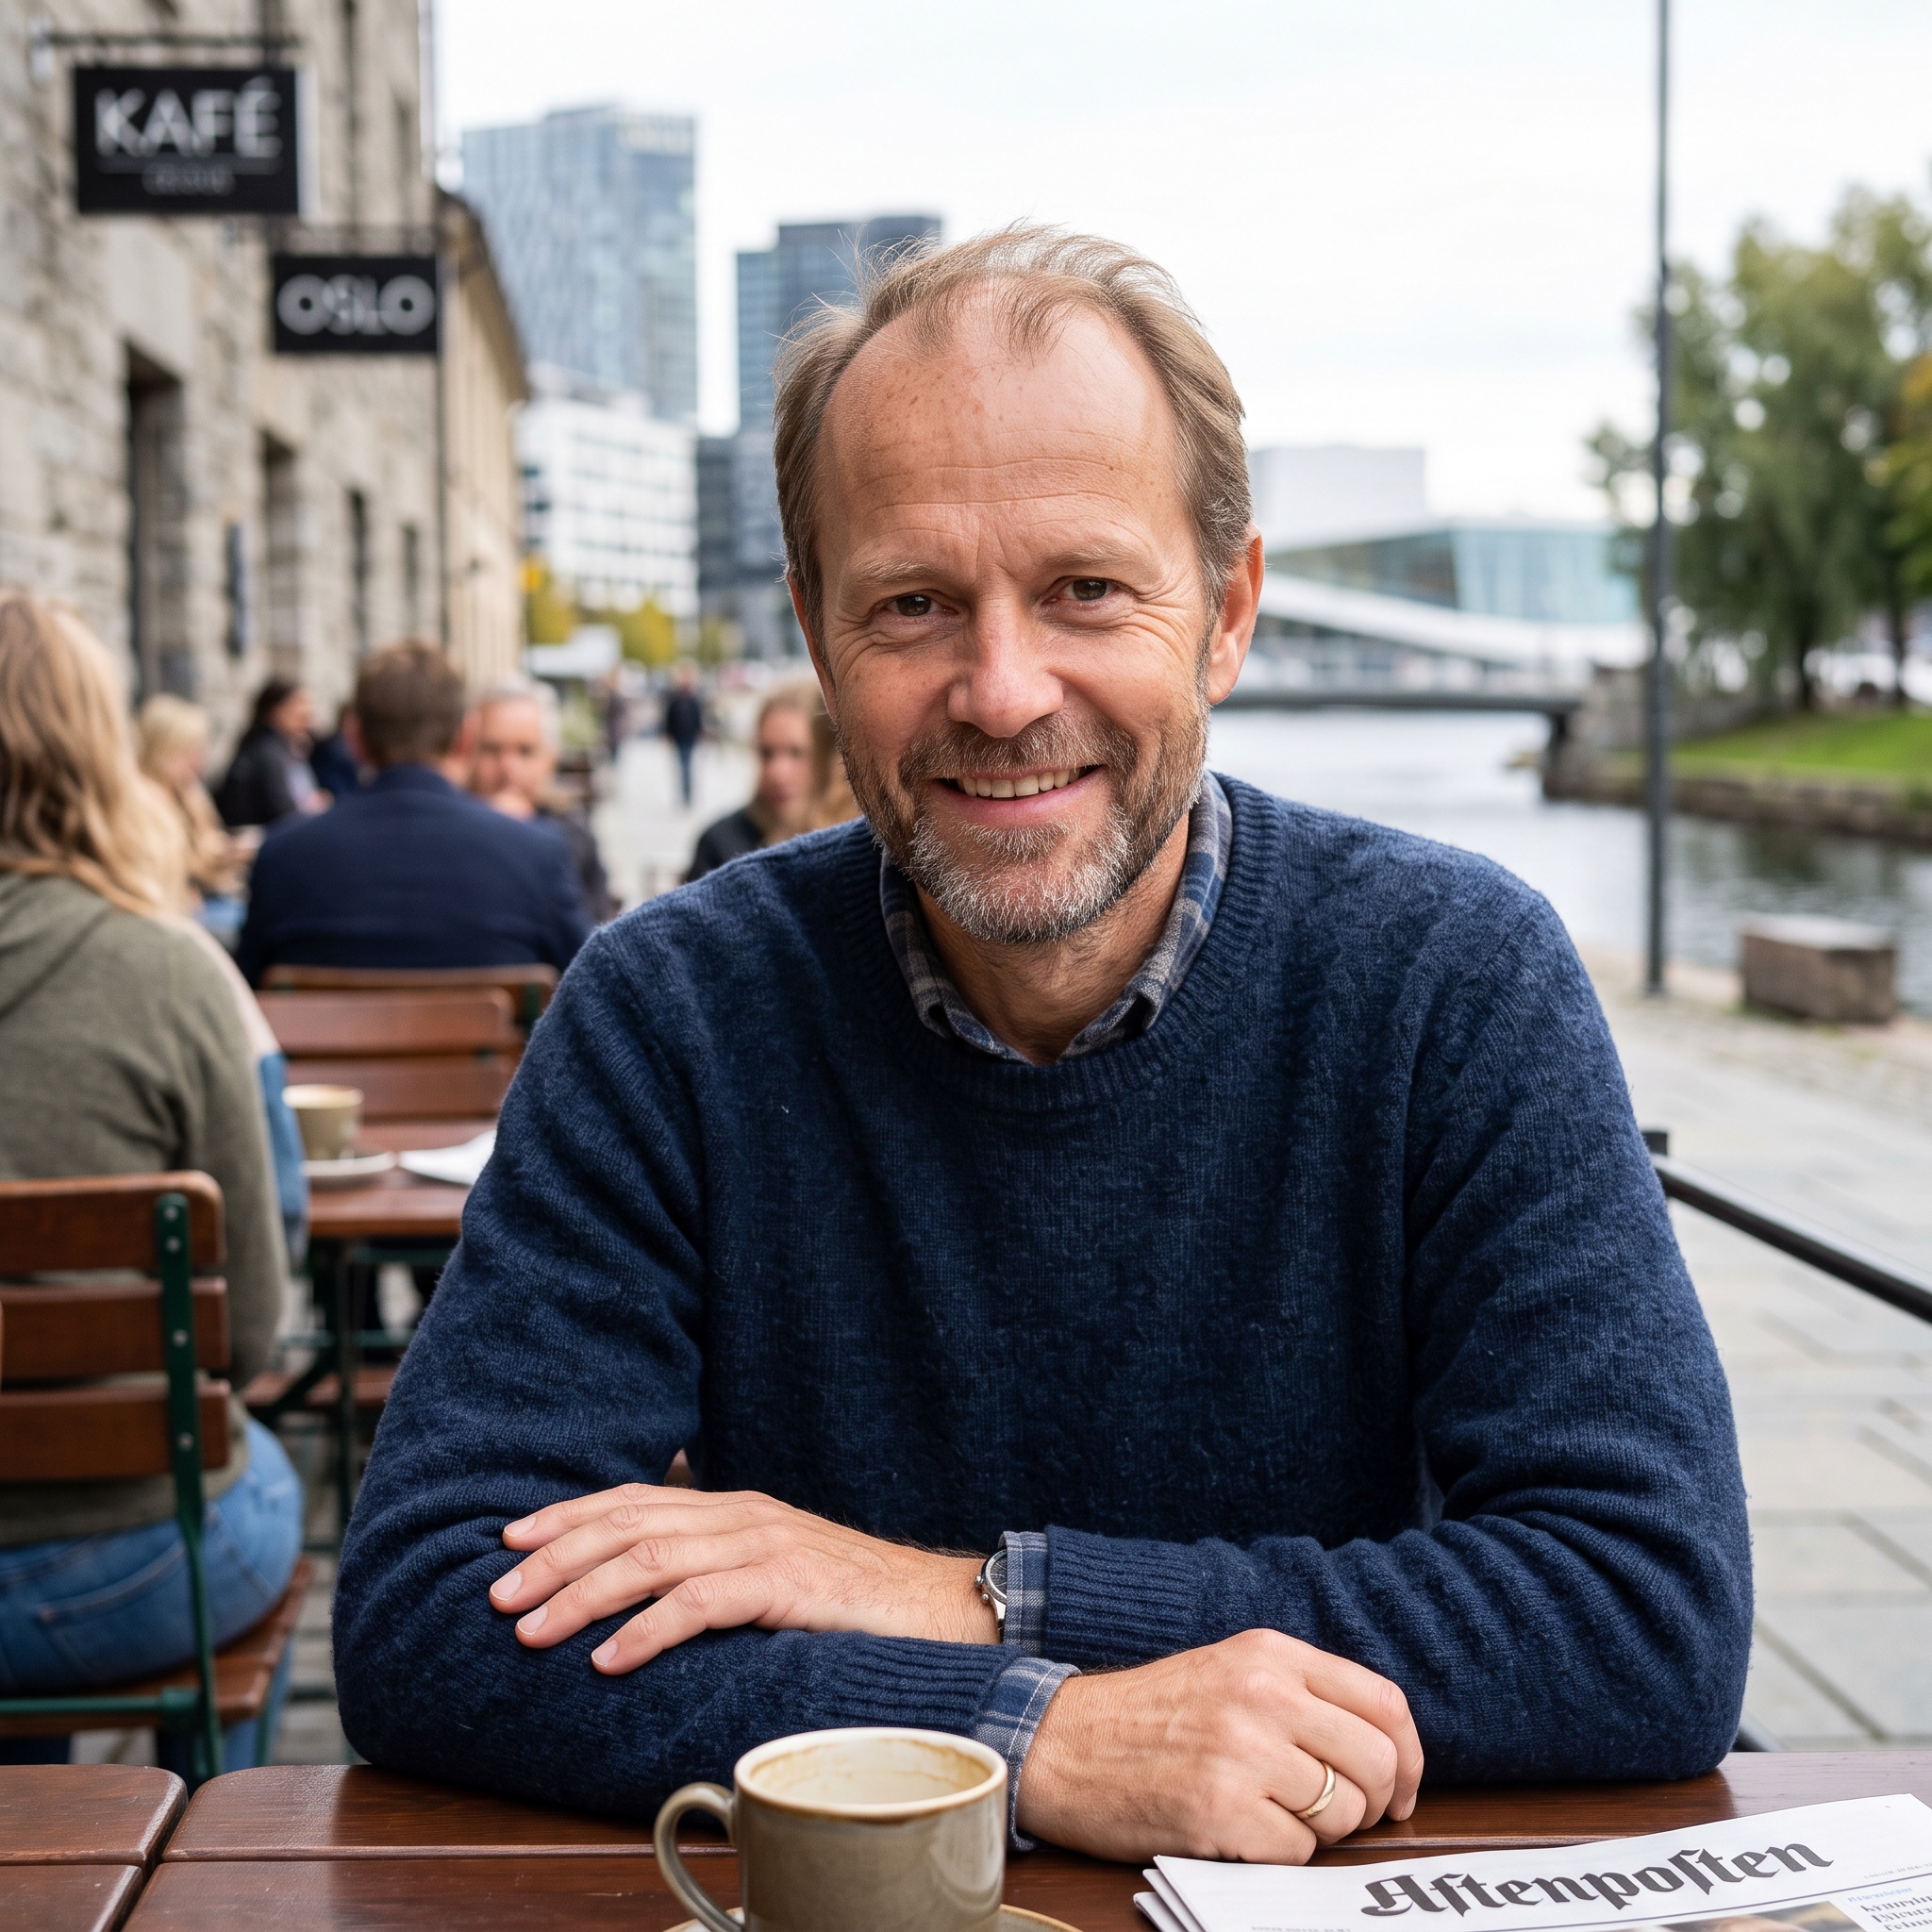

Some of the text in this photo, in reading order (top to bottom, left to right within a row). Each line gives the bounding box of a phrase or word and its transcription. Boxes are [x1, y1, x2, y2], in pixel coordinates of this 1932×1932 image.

[95, 76, 282, 158] KAFÉ
[277, 274, 435, 335] OSLO
[1360, 1842, 1835, 1918] Aftenposten
